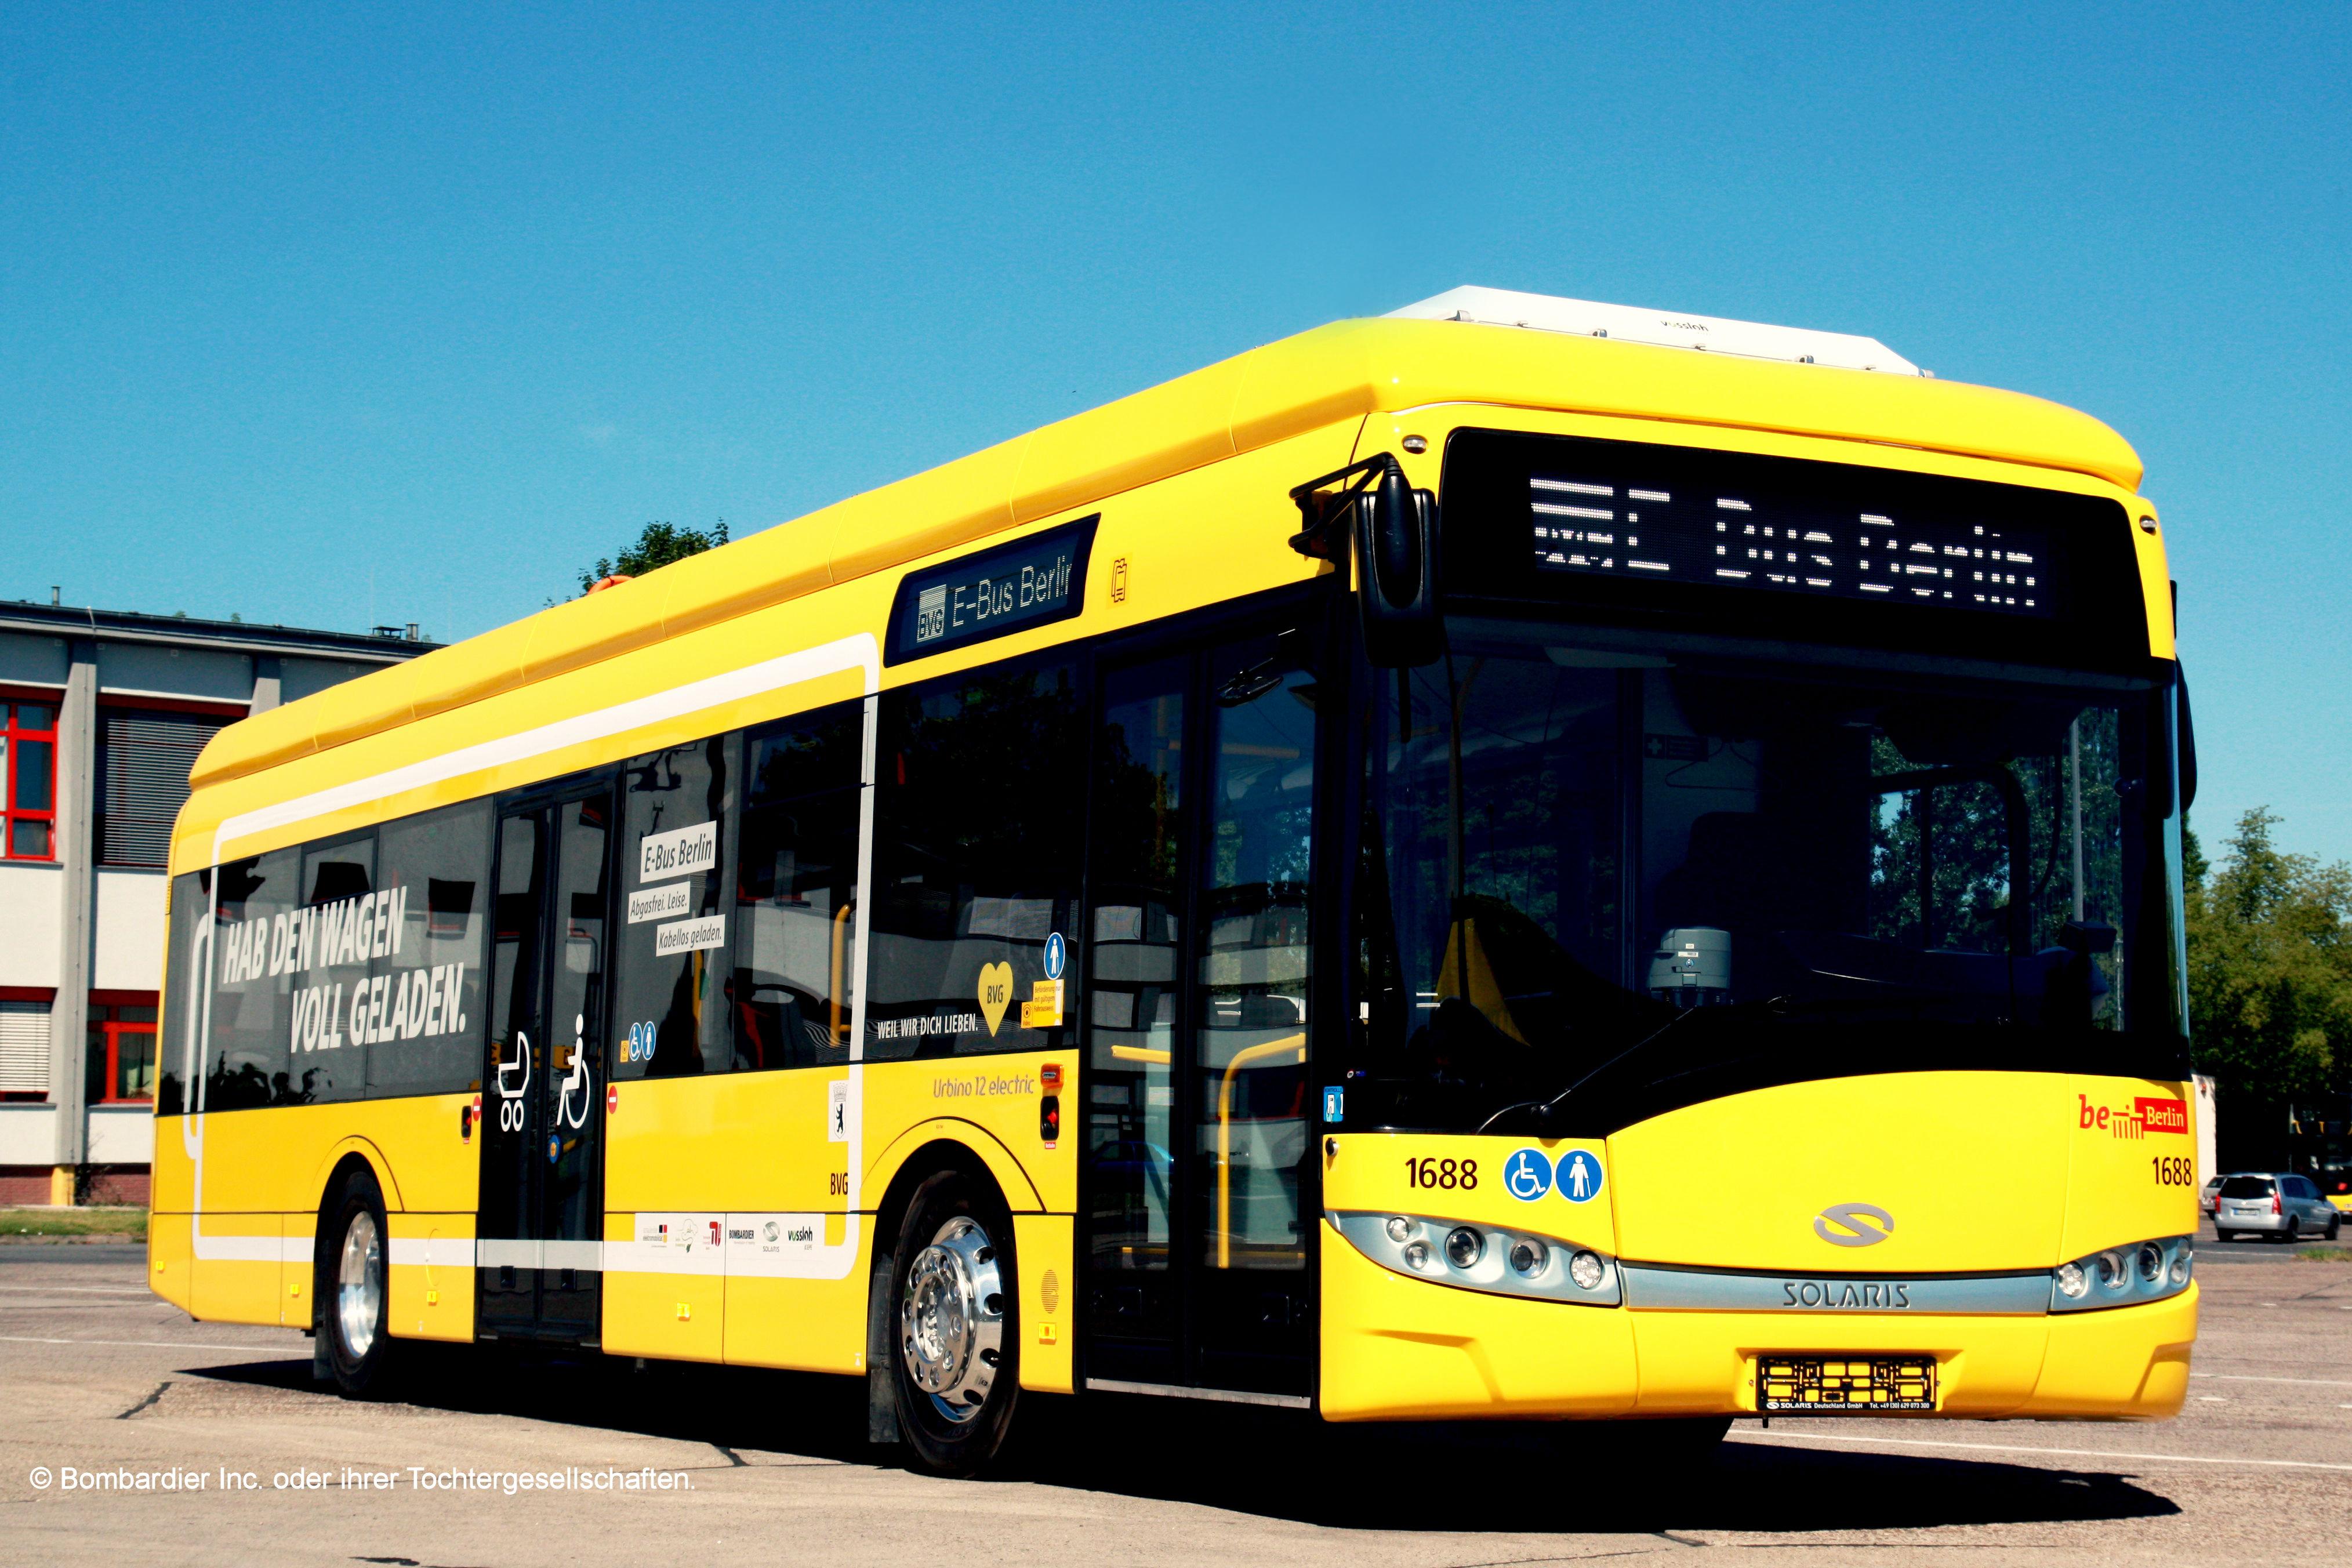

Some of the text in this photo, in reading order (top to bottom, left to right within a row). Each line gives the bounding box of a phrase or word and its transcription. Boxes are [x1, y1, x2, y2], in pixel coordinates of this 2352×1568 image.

[952, 579, 1013, 627] E-Bus
[644, 833, 713, 873] E-Bus Berlin
[630, 891, 687, 920] Abgasfrei. Leise.
[223, 885, 408, 984] HAB DEN WAGEN
[658, 923, 723, 949] Kabellos geladen.
[986, 984, 1004, 1004] BVG
[290, 962, 466, 1054] VOLL GELADEN.
[877, 1013, 979, 1039] WEIL WIR DICH LIEBEN.
[933, 1074, 1035, 1098] Urbino 12 electric
[2078, 1094, 2184, 1130] be Berlin
[830, 1172, 848, 1195] BVG
[1406, 1157, 1478, 1190] 1688
[2152, 1156, 2193, 1186] 1688
[728, 1229, 754, 1239] BOMBARDIER
[787, 1226, 813, 1242] vossloh
[1784, 1282, 1910, 1308] SOLARIS
